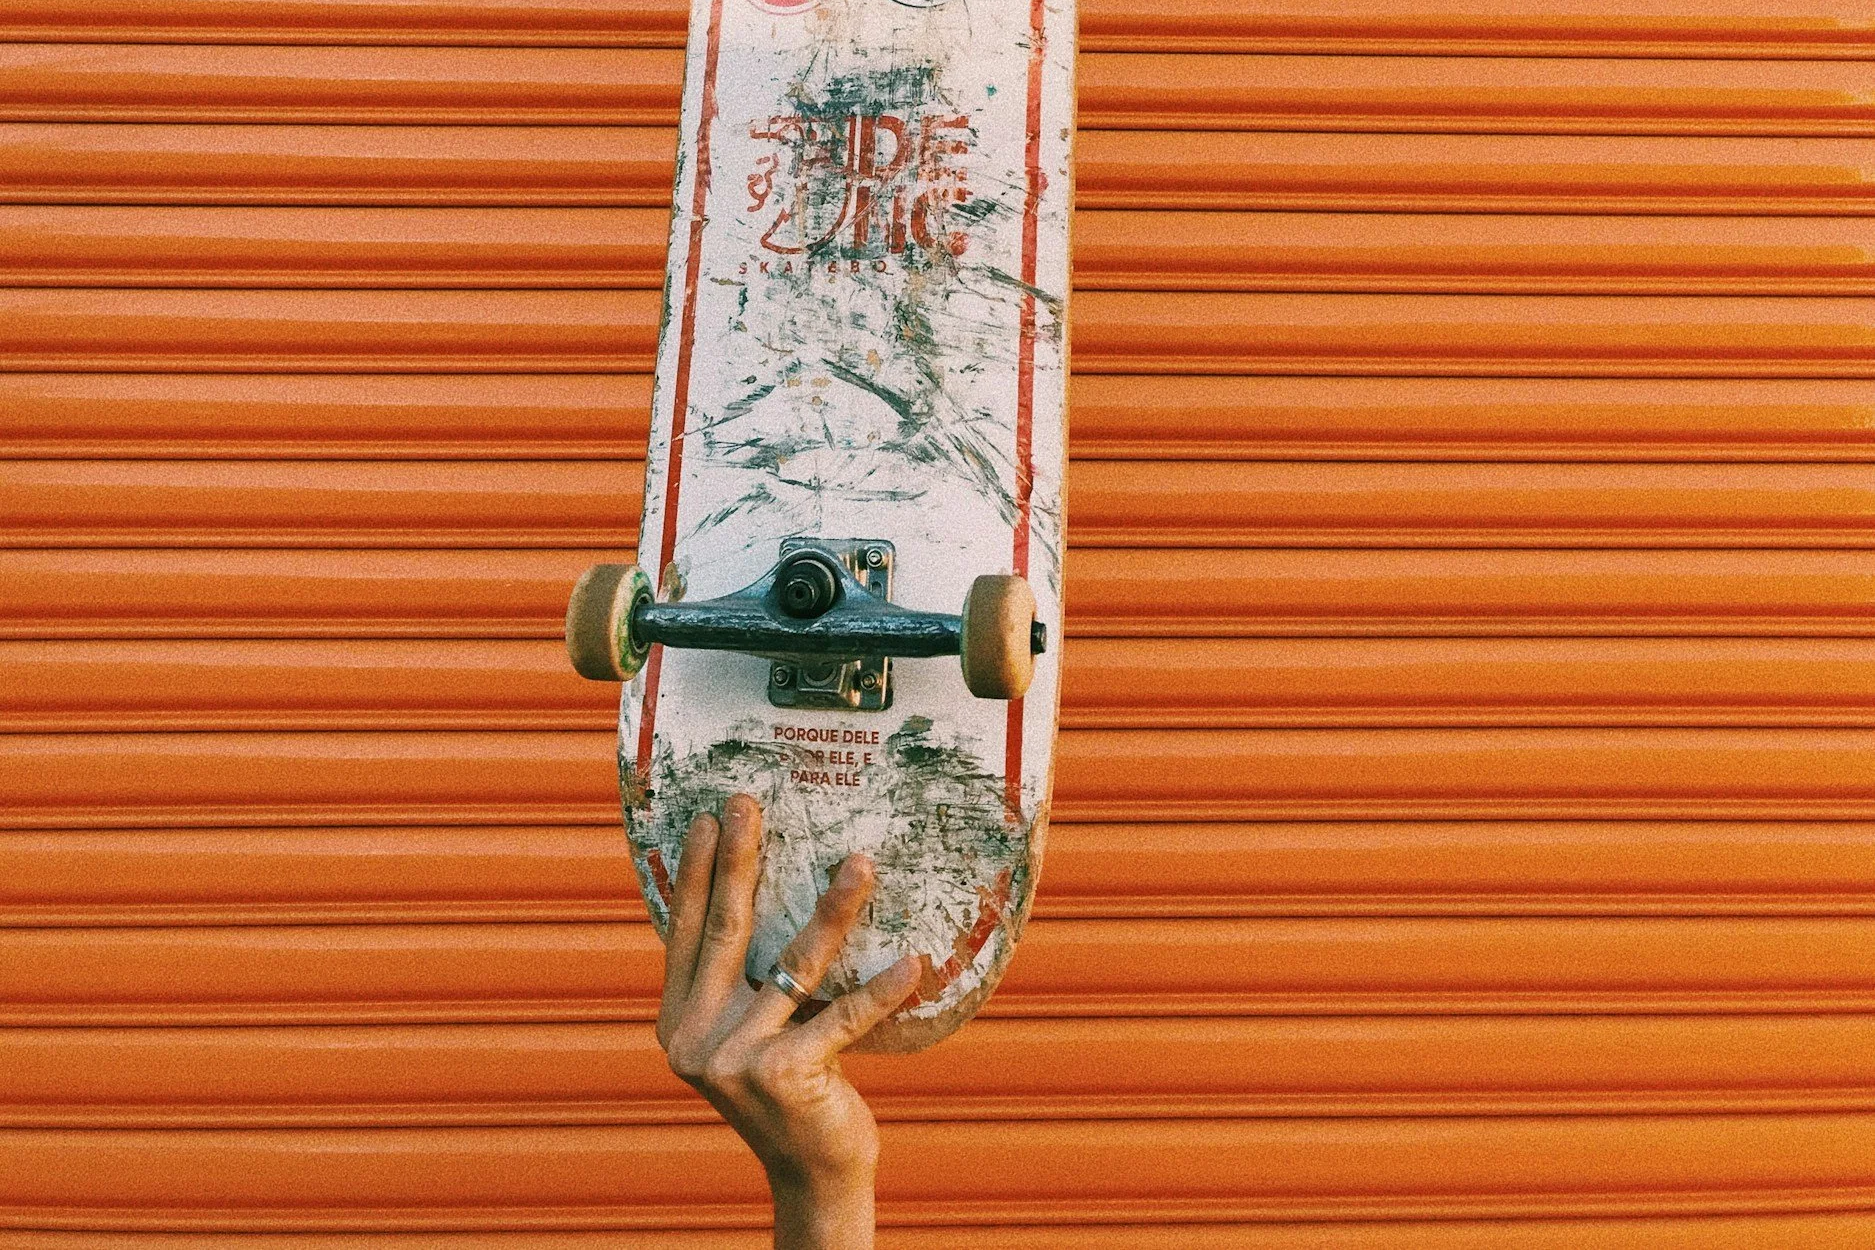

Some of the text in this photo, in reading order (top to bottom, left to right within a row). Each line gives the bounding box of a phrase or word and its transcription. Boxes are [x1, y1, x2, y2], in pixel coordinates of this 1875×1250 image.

[774, 726, 880, 745] PORQUE DELE
[829, 751, 859, 767] ELE,
[863, 752, 873, 765] E
[790, 769, 860, 787] PARA ELE
